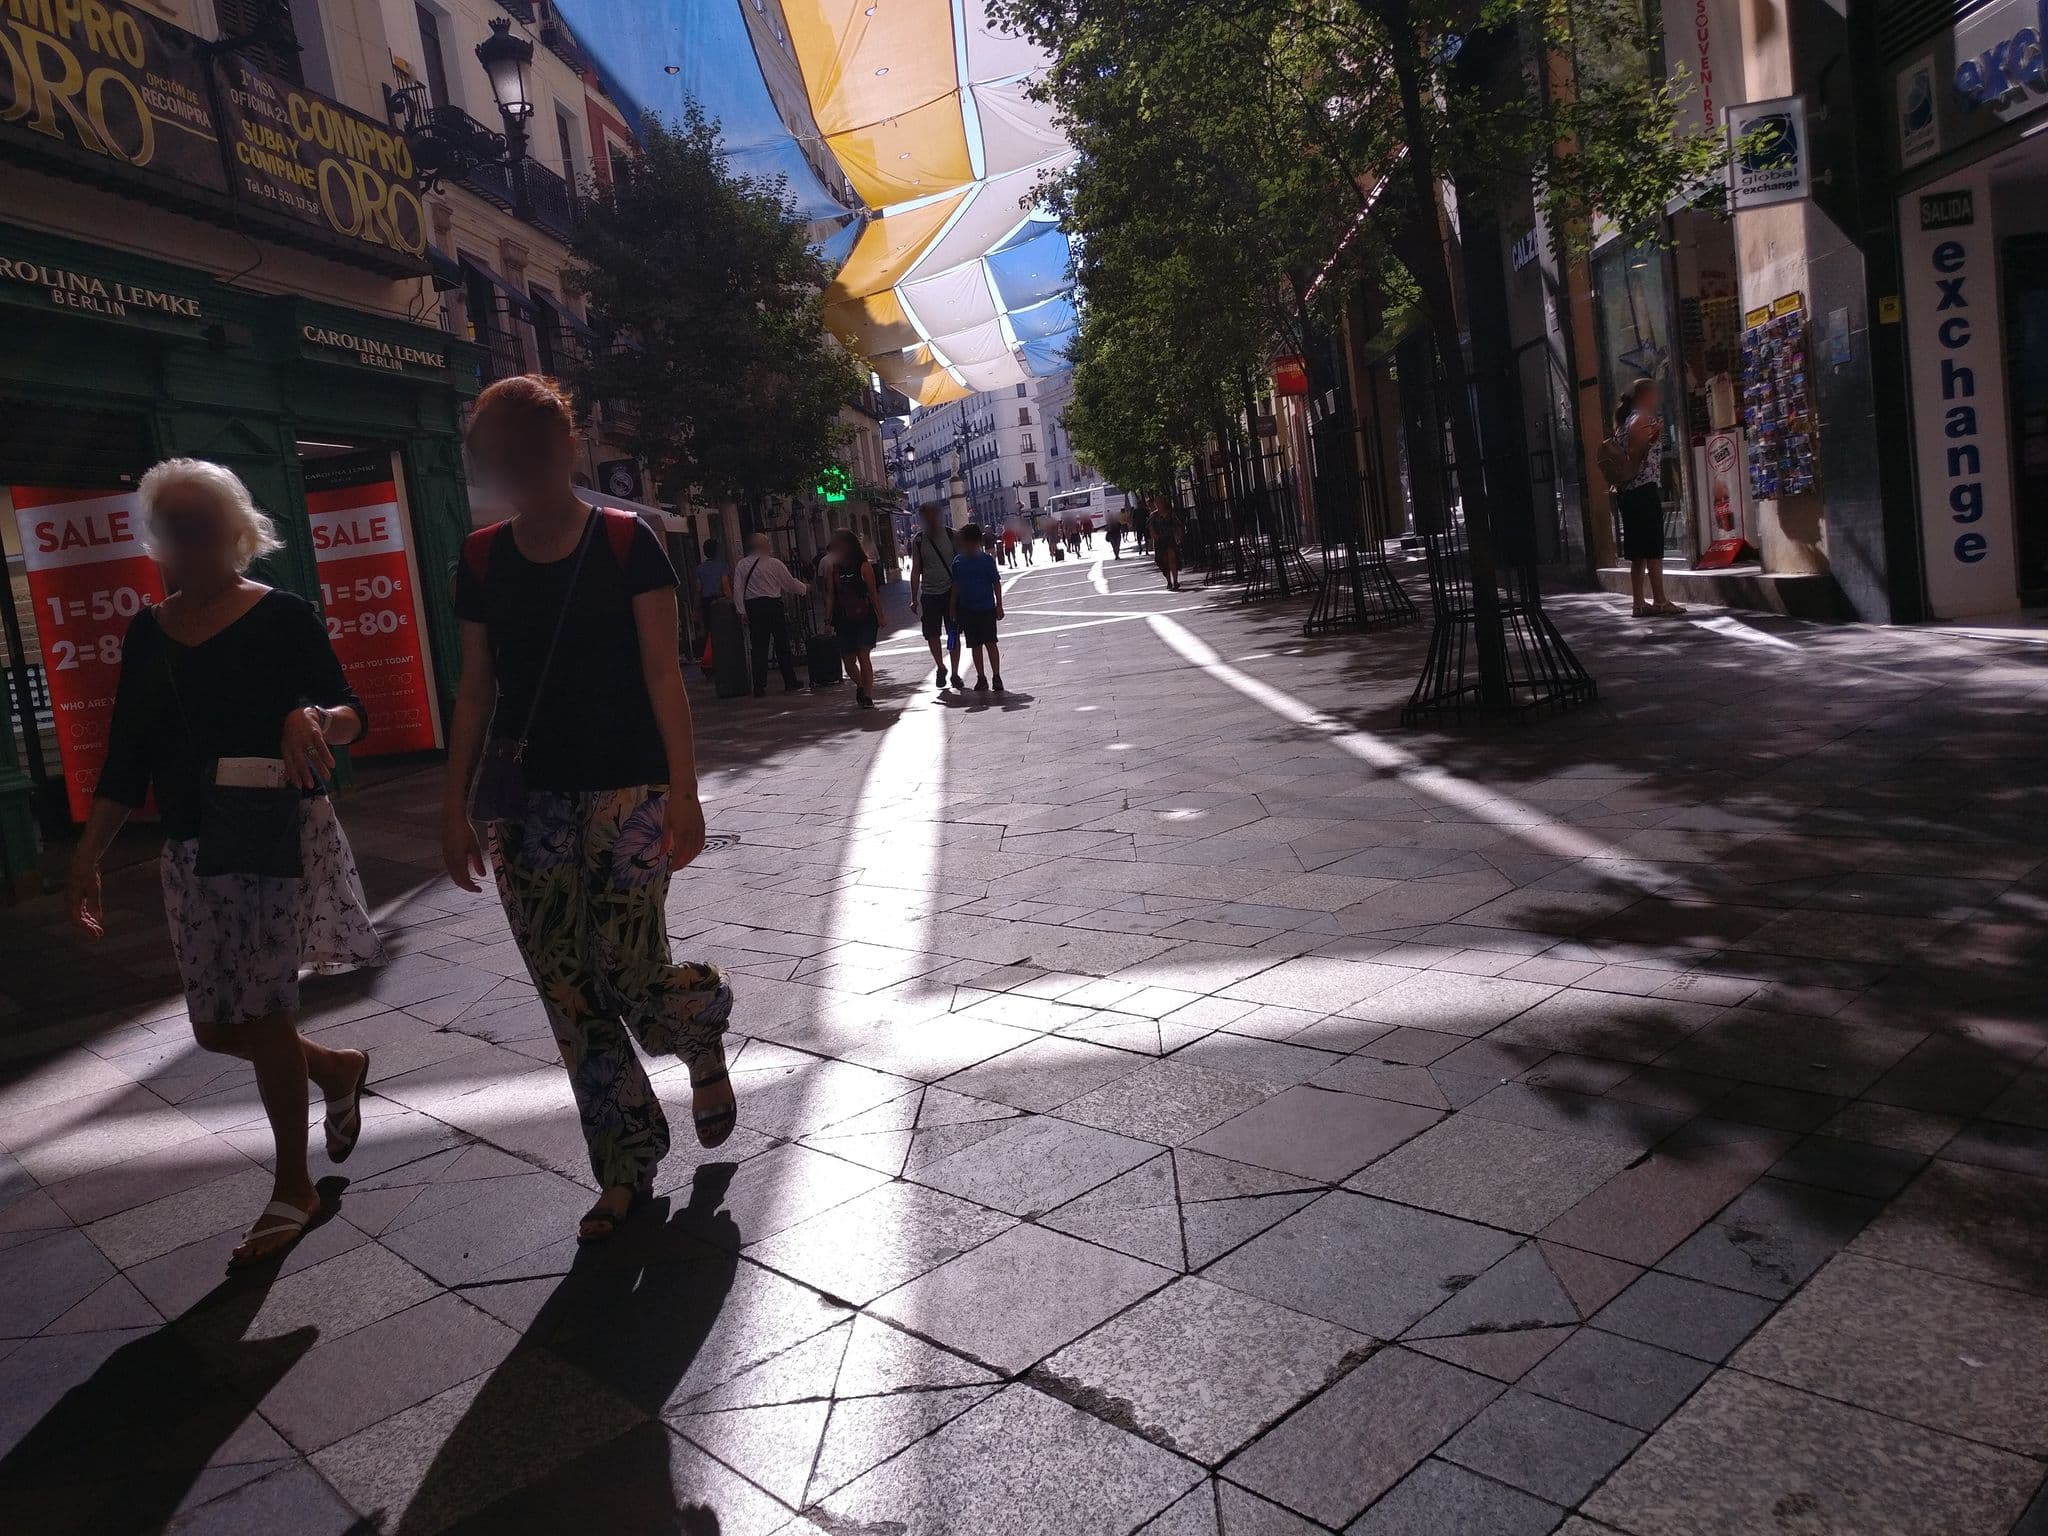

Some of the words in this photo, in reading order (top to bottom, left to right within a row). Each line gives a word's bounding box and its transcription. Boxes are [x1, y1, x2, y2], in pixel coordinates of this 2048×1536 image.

[1695, 0, 1714, 127] SOUVENIRS
[140, 85, 213, 129] RECOMPRA
[230, 88, 275, 120] OFICINA
[241, 118, 288, 157] SUBA
[286, 135, 299, 160] Y
[287, 92, 414, 180] COMPRO
[235, 141, 318, 191] COMPARE
[1741, 167, 1799, 186] global
[245, 177, 263, 195] Tel.
[263, 183, 277, 200] 91
[1742, 179, 1801, 196] exchange
[318, 157, 428, 261] ORO
[1921, 195, 1973, 227] SALIDA
[1512, 226, 1539, 272] CALZ
[52, 288, 127, 318] BERLIN
[113, 282, 203, 318] LEMKE
[302, 324, 394, 359] CAROLINA
[394, 344, 447, 369] LEMKE
[359, 351, 403, 372] BERLIN
[1932, 240, 1988, 564] exchange
[34, 510, 136, 554] SALE
[312, 516, 390, 550] SALE
[51, 634, 124, 672] 2=8
[366, 658, 384, 668] YOU
[59, 700, 86, 712] WHO
[87, 697, 109, 709] ARE
